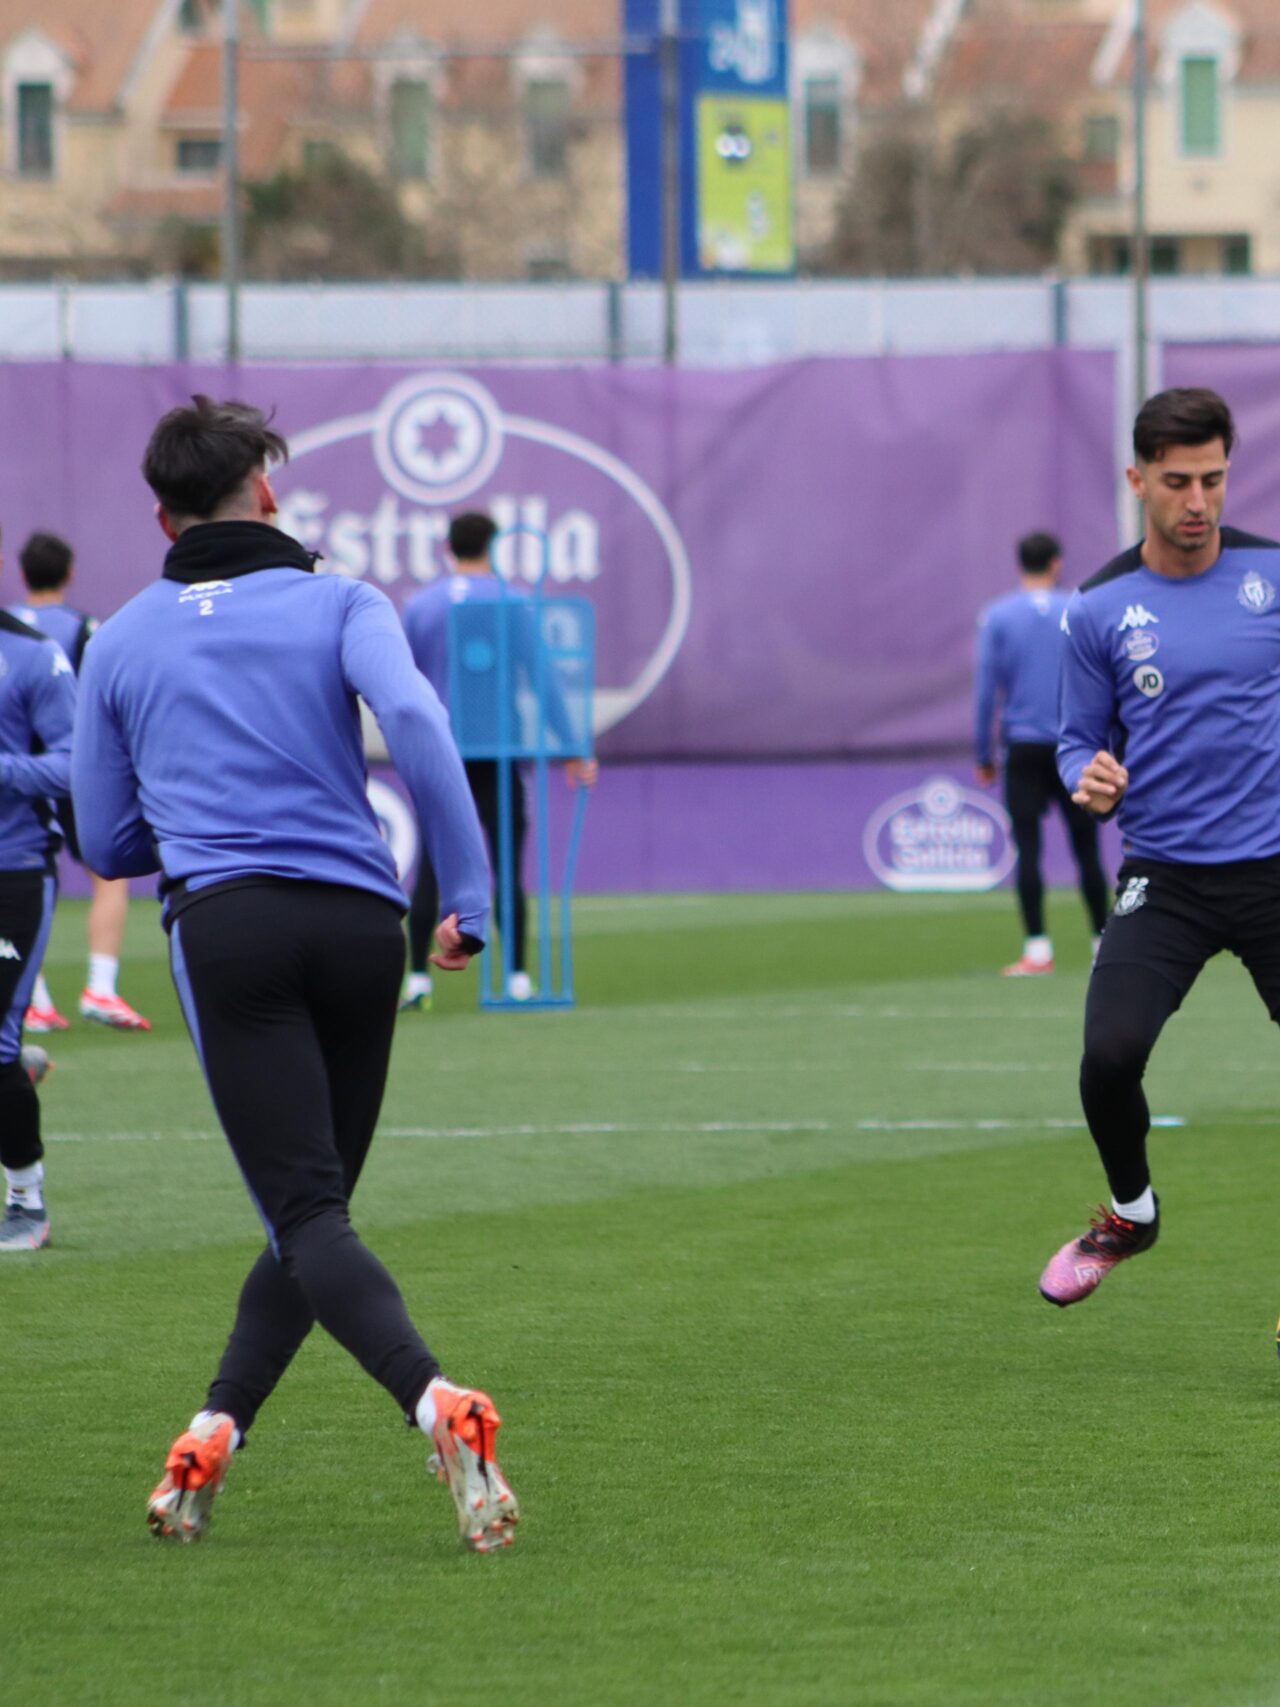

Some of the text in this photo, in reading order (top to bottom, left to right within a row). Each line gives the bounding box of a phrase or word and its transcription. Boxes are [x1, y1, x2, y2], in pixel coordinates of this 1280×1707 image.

[278, 489, 600, 584] Estrlla
[199, 599, 215, 616] 2
[1141, 672, 1160, 690] JD
[1127, 876, 1150, 892] 22
